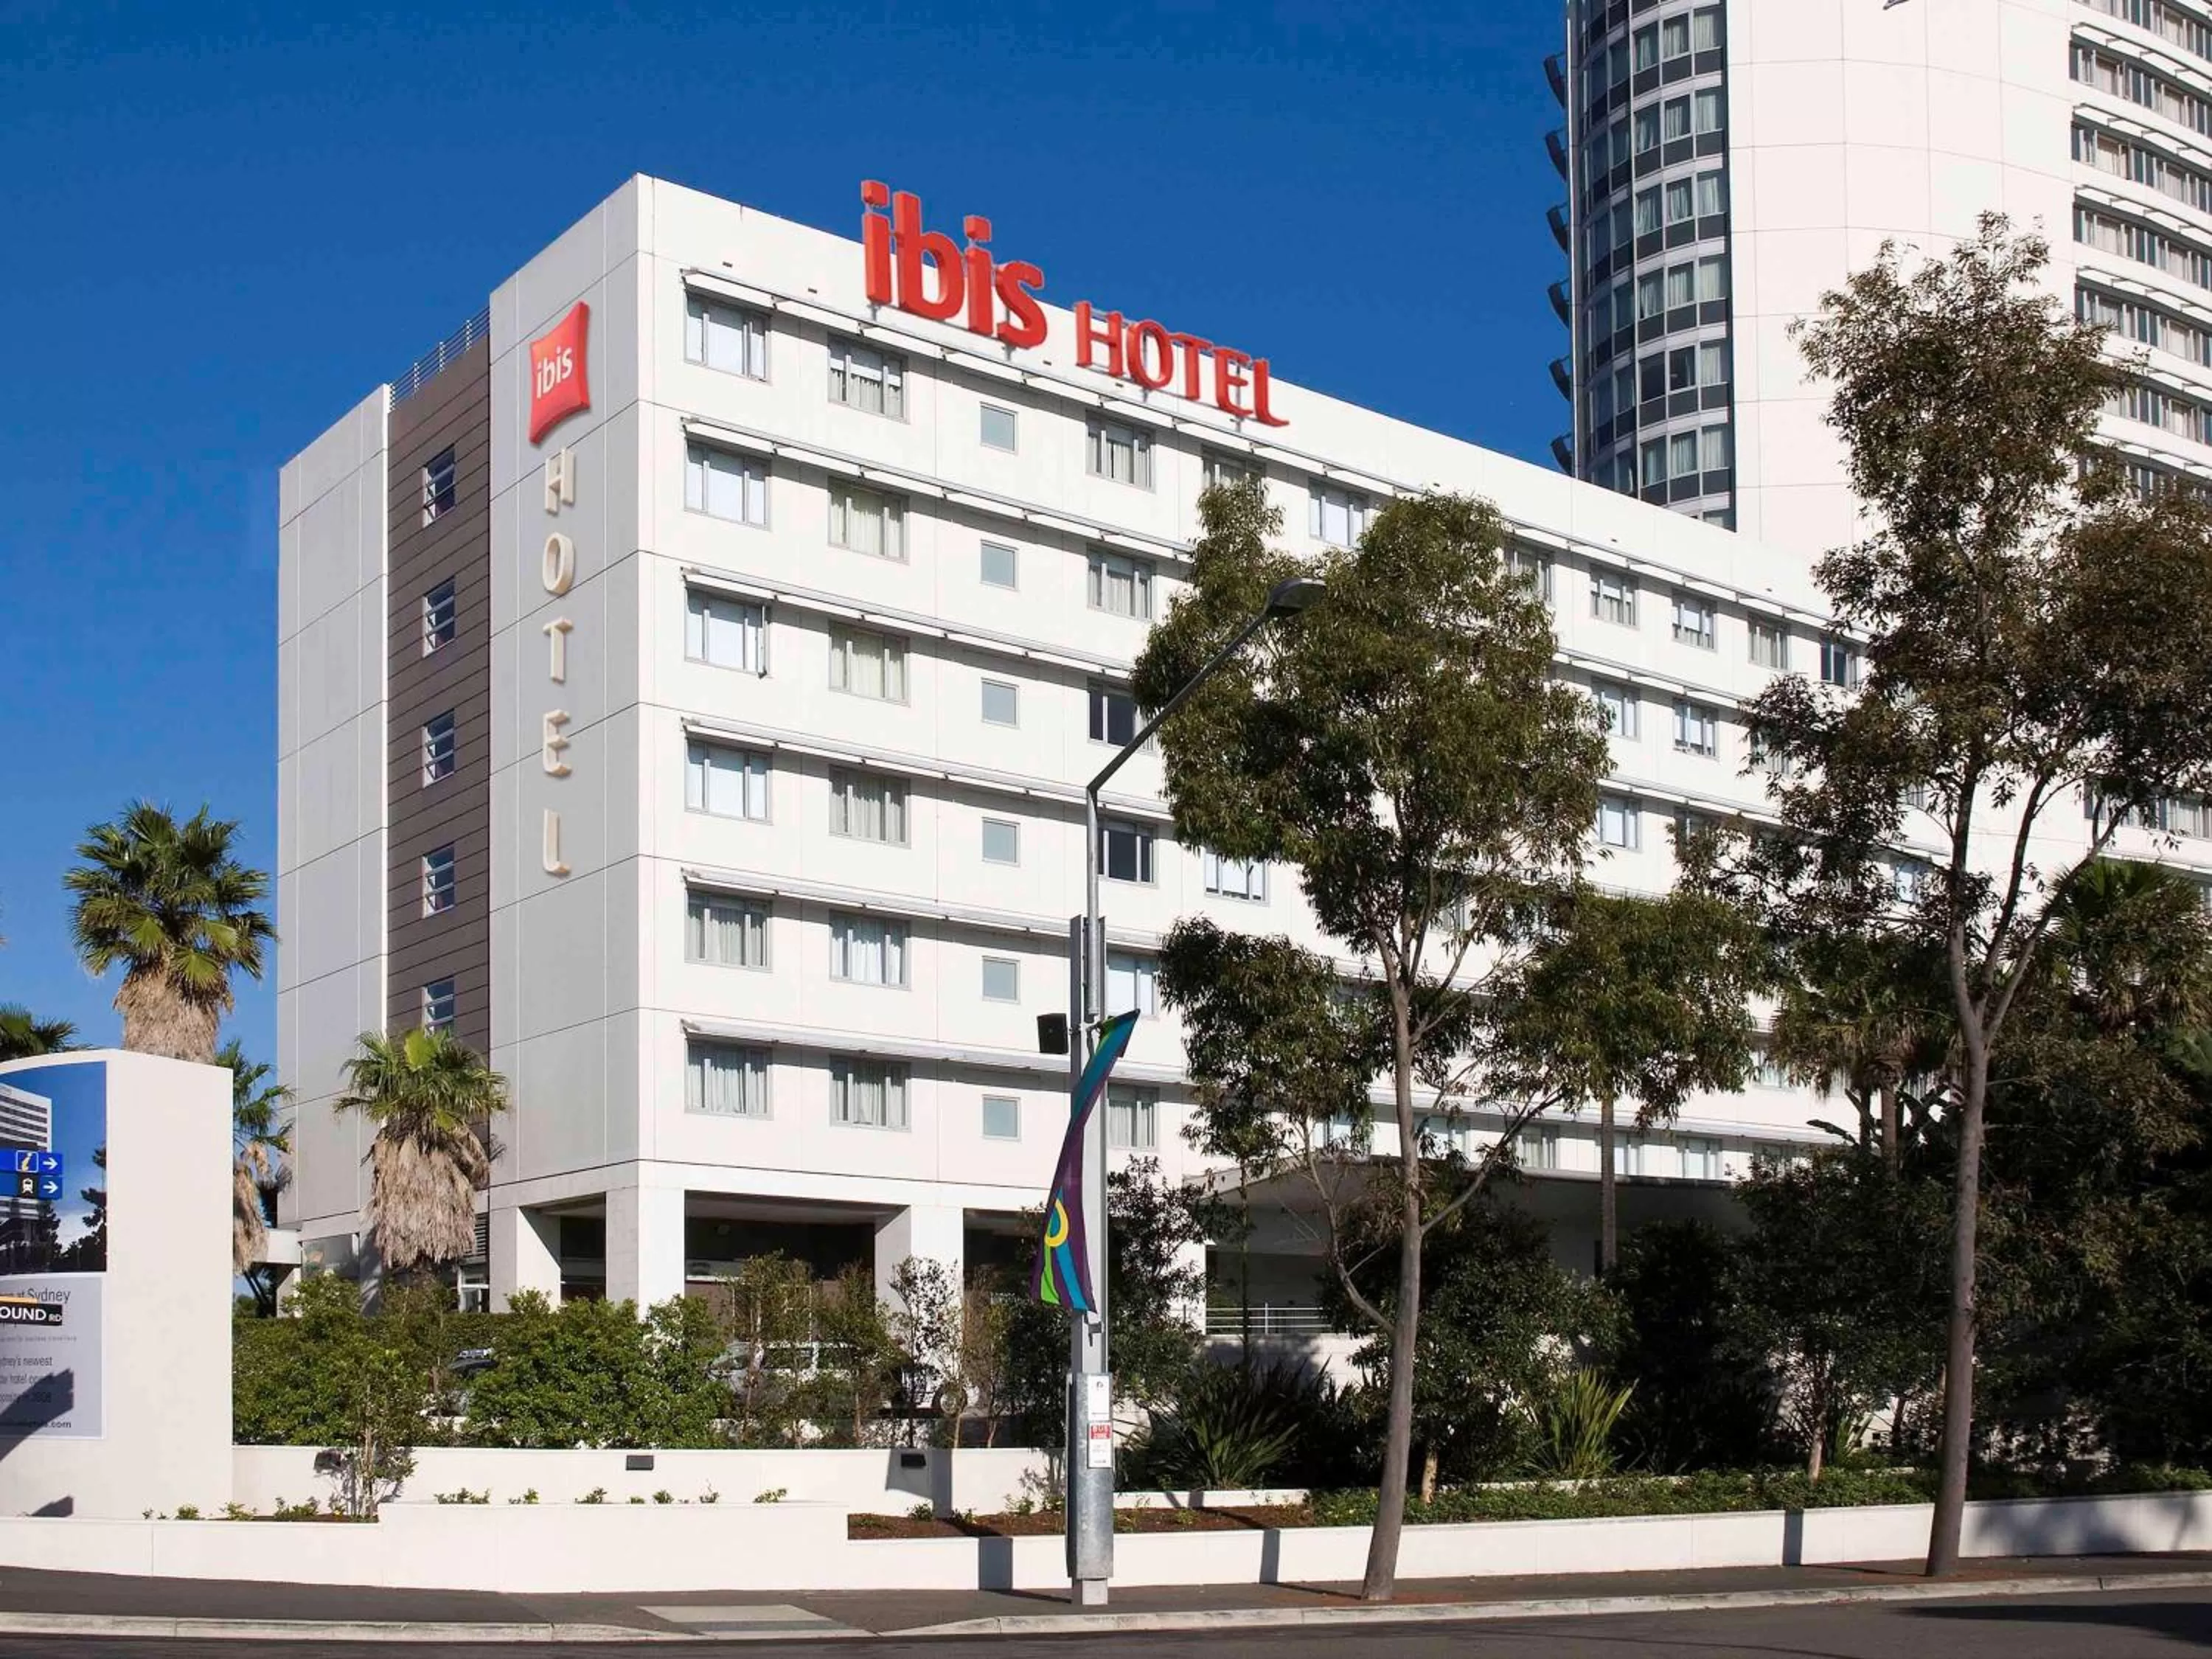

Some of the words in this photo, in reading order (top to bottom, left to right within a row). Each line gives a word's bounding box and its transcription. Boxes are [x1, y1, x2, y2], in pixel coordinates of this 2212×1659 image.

[861, 179, 1047, 349] ibis
[1074, 299, 1290, 428] HOTEL
[536, 344, 573, 400] ibis
[542, 445, 575, 877] HOTEL
[0, 1306, 47, 1321] OUND
[48, 1313, 63, 1322] RD
[27, 1287, 72, 1304] Sydney
